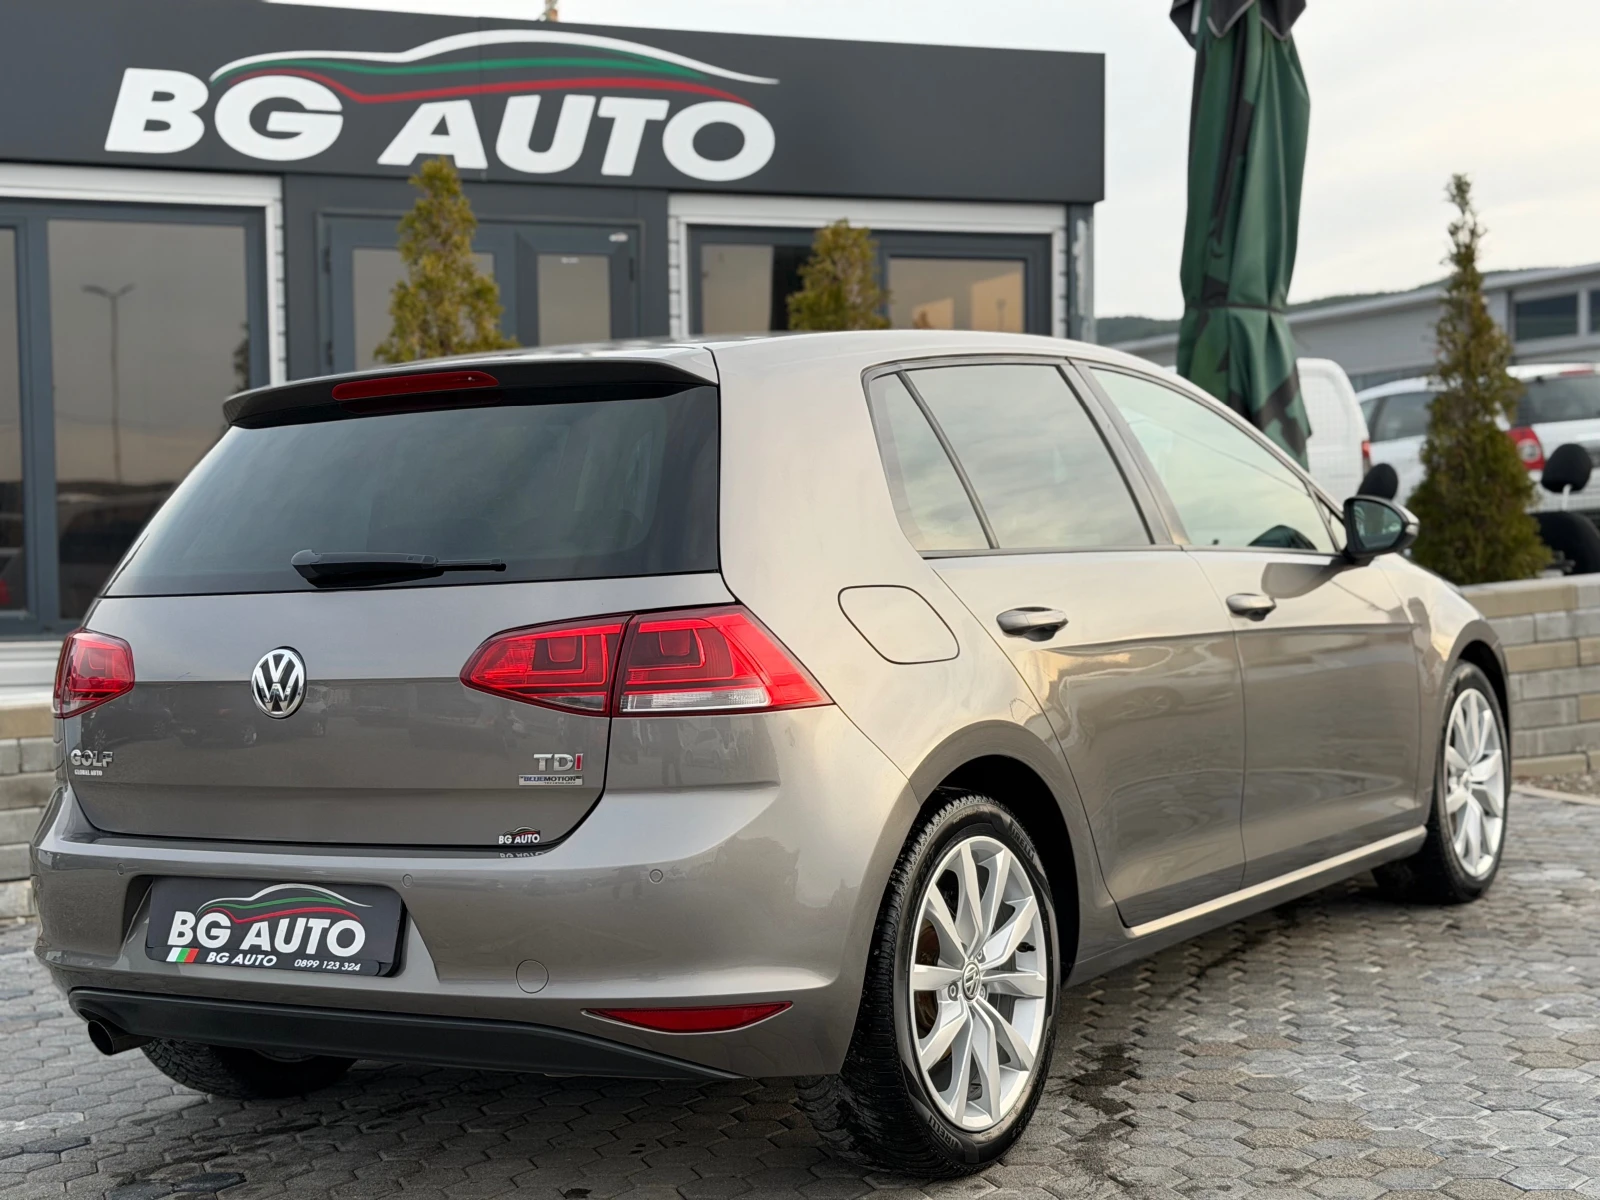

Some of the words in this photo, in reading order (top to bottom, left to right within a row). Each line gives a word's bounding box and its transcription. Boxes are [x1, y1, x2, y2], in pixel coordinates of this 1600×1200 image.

[104, 68, 343, 161] BG
[377, 93, 776, 182] AUTO
[71, 749, 113, 767] GOLF
[533, 753, 584, 771] TDI
[498, 835, 512, 844] BG
[514, 833, 540, 844] AUTO
[167, 910, 232, 949] BG
[239, 917, 366, 957] AUTO
[206, 952, 230, 964] BG
[231, 953, 278, 967] AUTO
[294, 959, 319, 969] 0899
[322, 960, 340, 970] 123
[341, 962, 361, 972] 324
